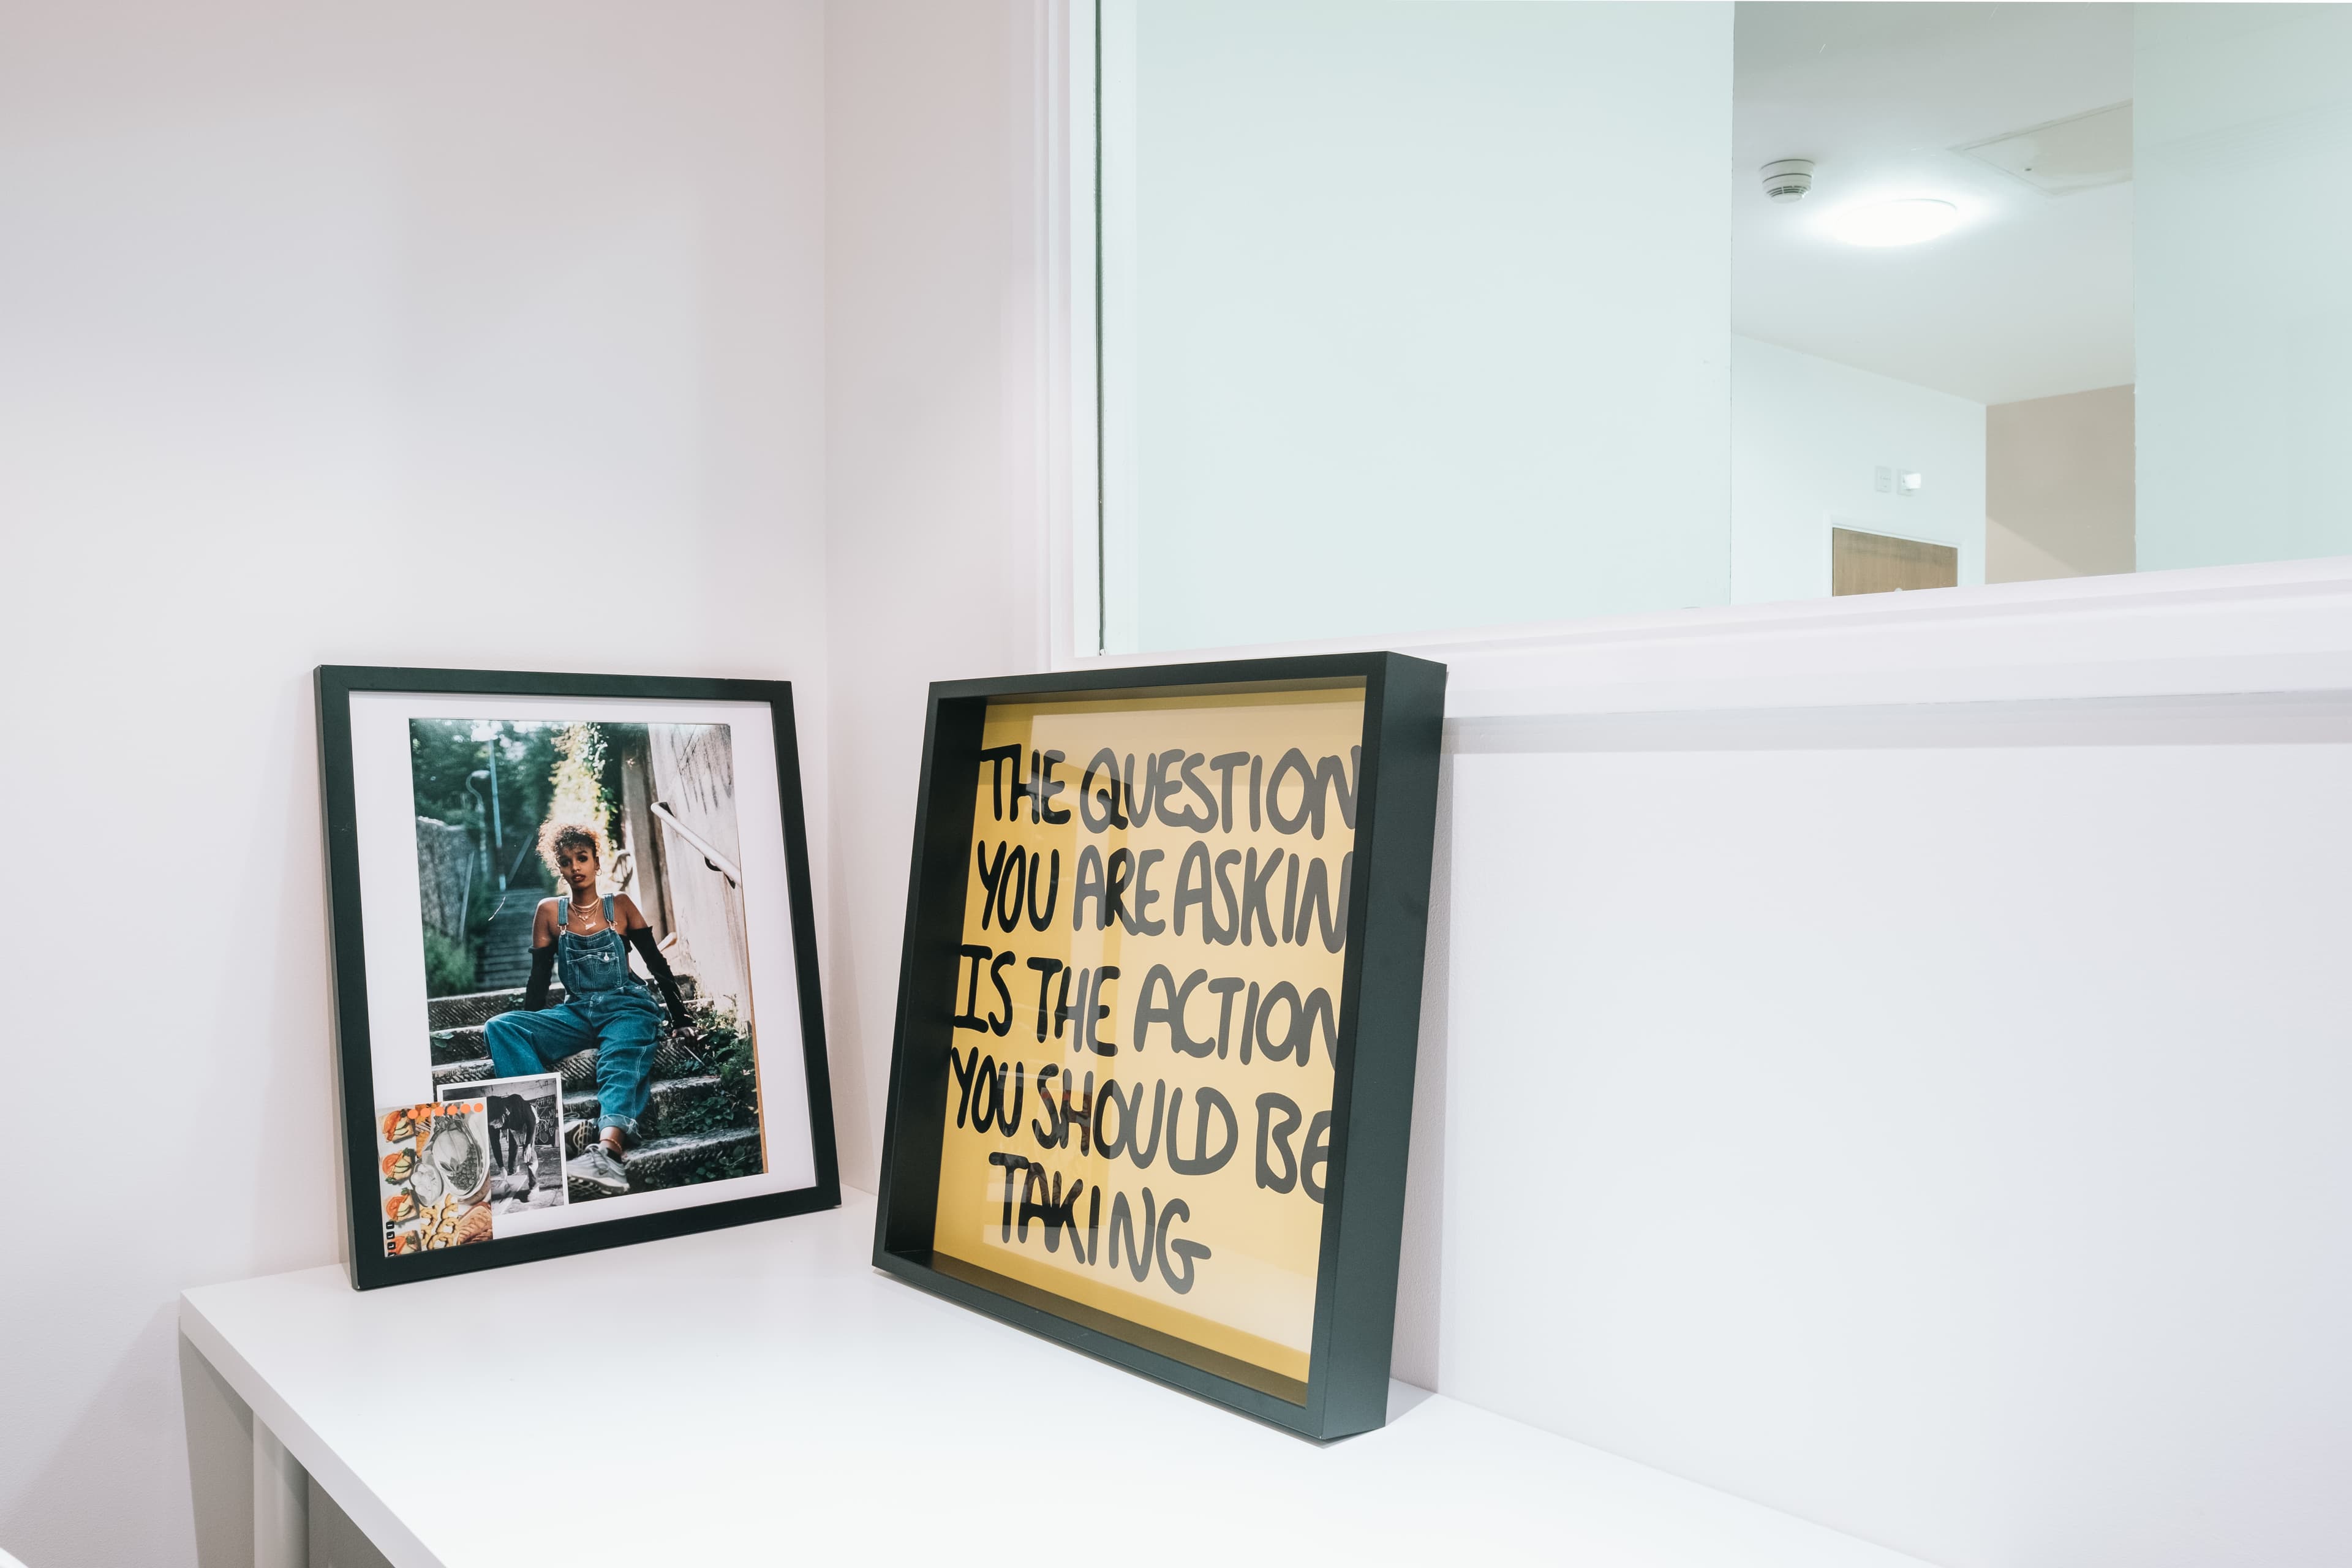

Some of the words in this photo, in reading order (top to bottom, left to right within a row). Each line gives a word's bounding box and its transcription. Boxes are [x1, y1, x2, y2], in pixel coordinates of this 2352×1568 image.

[981, 743, 1071, 824] THE
[1080, 745, 1362, 840] QUESTION
[978, 840, 1059, 933] YOU
[1073, 845, 1166, 936] ARE
[954, 944, 1016, 1036] IS
[1027, 957, 1121, 1057] THE
[1133, 963, 1338, 1071] ACTION
[951, 1046, 1023, 1137] YOU
[1031, 1063, 1238, 1175] SHOULD
[1256, 1092, 1333, 1204] BE
[989, 1152, 1212, 1295] TAKING
